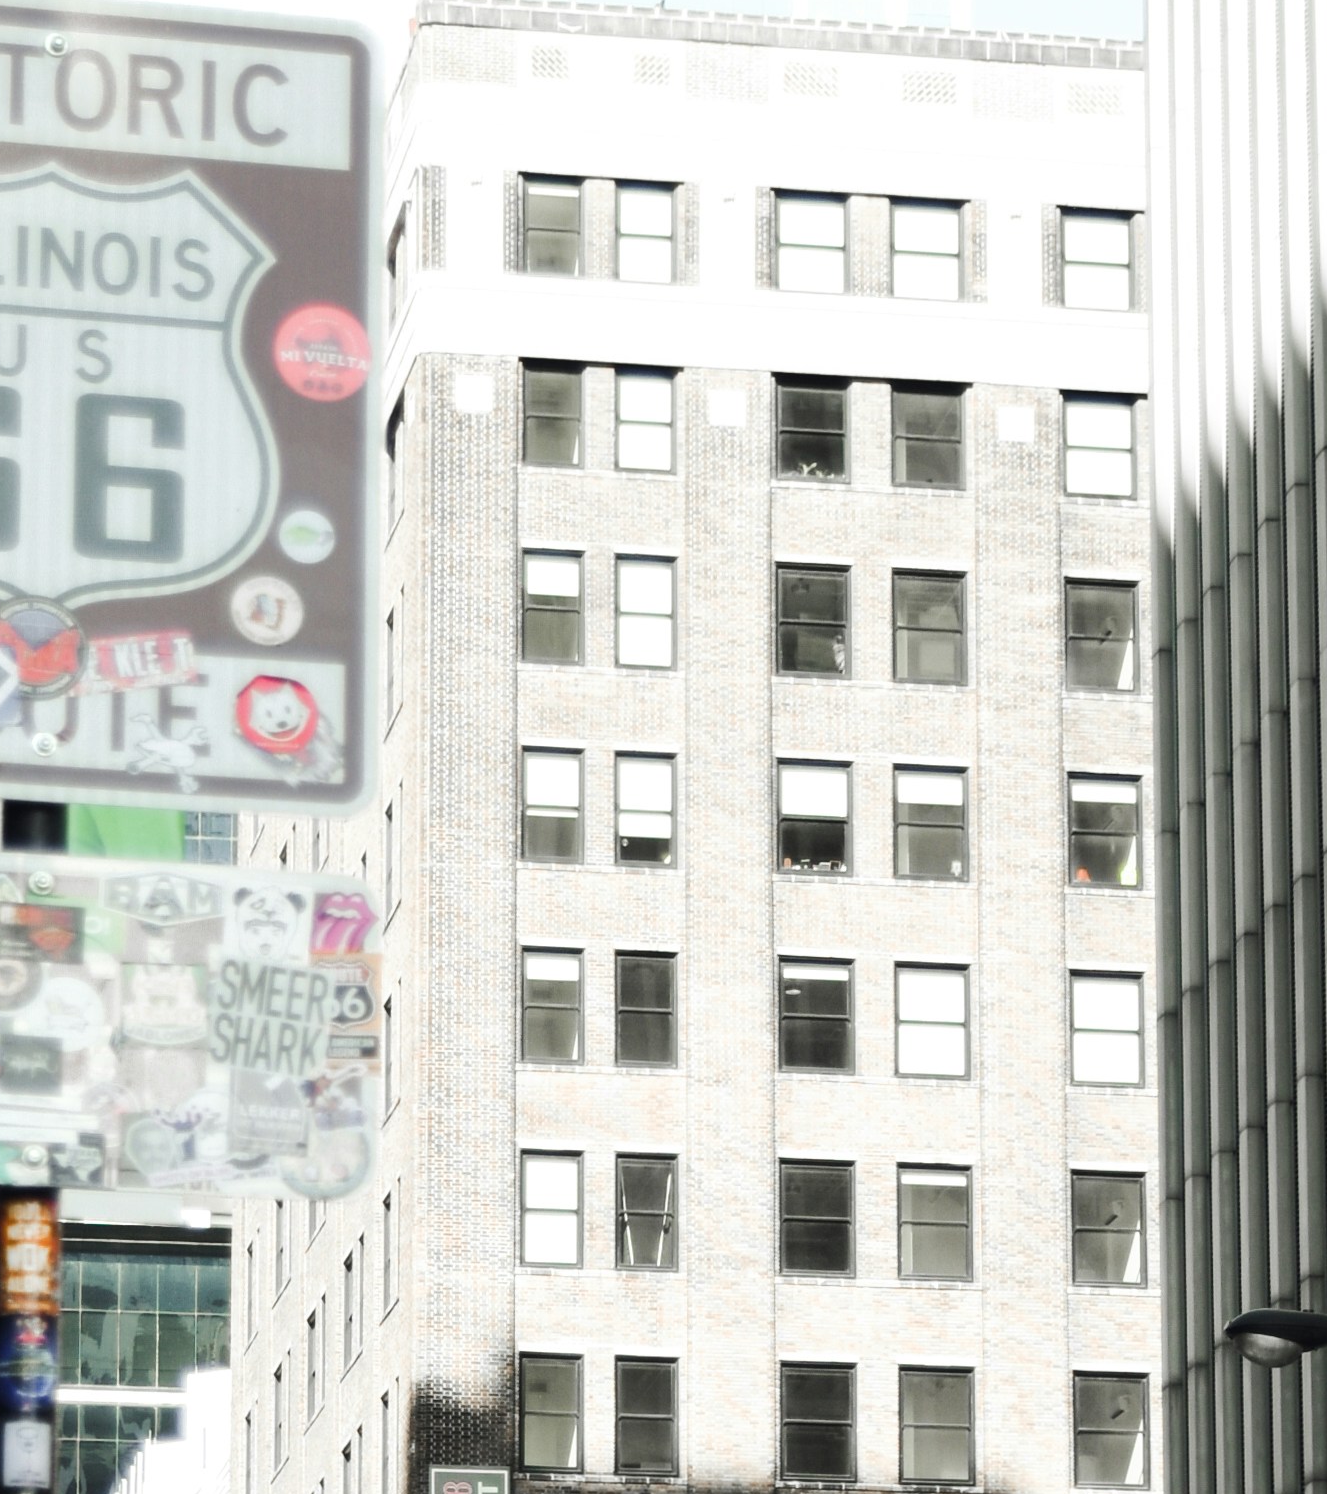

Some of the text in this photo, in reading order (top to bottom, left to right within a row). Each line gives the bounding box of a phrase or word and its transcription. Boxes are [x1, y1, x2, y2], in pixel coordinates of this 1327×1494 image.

[76, 329, 114, 384] S
[219, 959, 329, 1024] SMEER
[209, 1013, 323, 1077] SHARK
